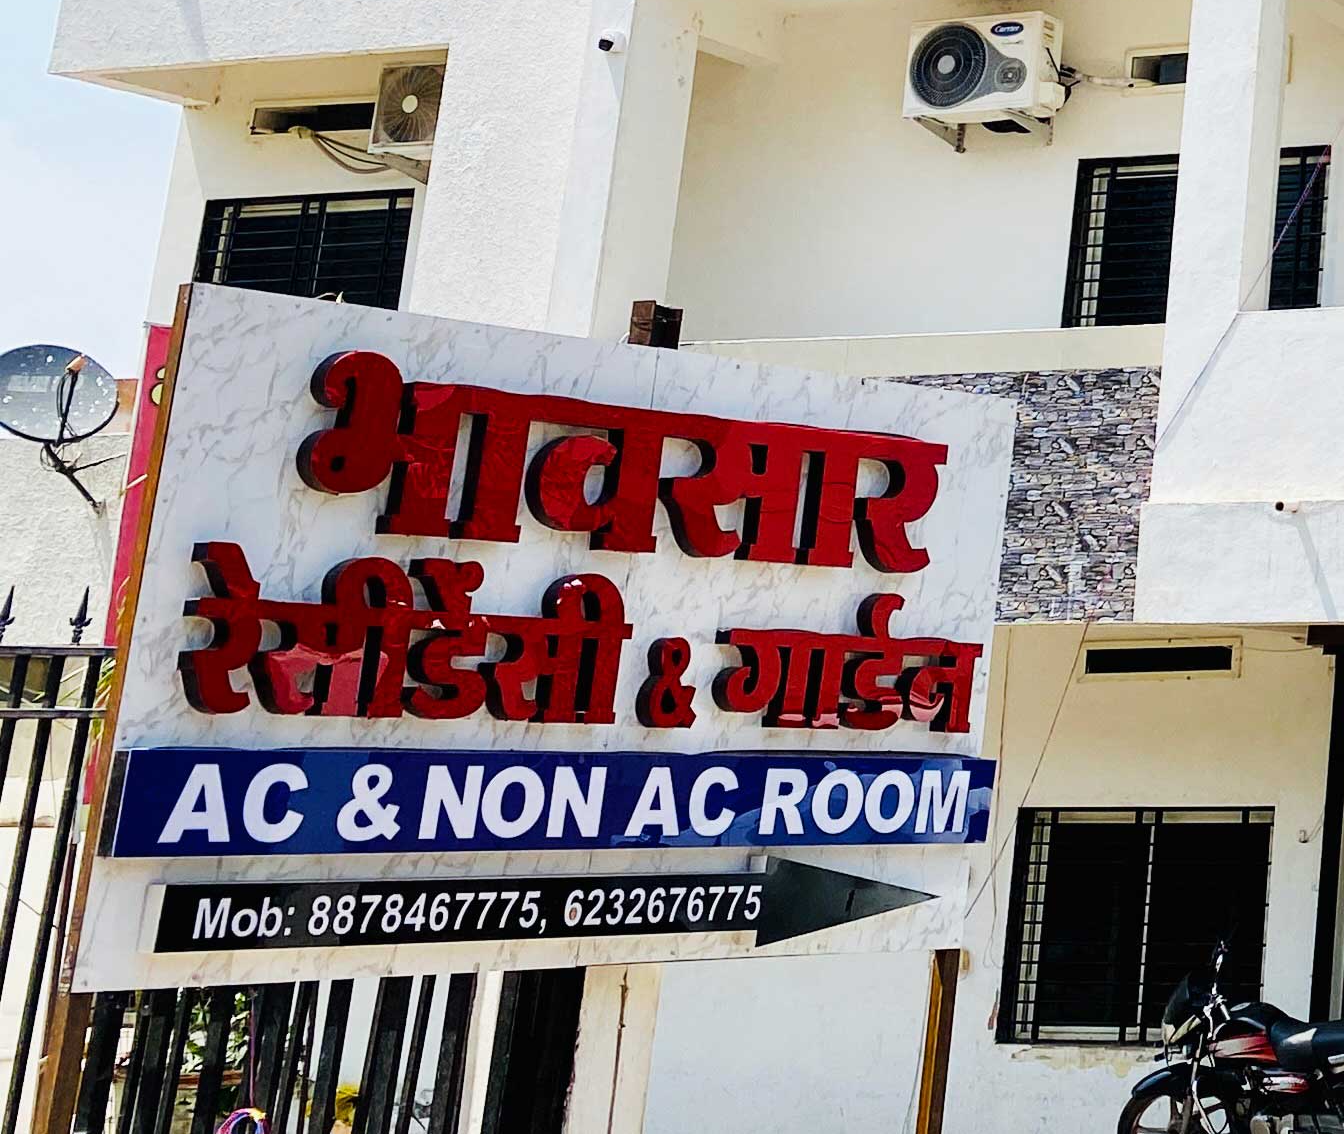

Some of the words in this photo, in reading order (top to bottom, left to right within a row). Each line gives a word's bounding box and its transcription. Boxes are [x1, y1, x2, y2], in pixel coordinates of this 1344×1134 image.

[298, 351, 948, 574] भावसार
[636, 637, 697, 728] &
[712, 593, 983, 733] गार्डन
[157, 763, 309, 843] AC
[336, 763, 401, 842] &
[418, 765, 608, 840] NON
[624, 766, 739, 837] AC
[758, 768, 972, 835] ROOM
[192, 896, 295, 940] Mob:
[307, 890, 548, 935] 8878467775,
[564, 885, 763, 927] 6232676775
